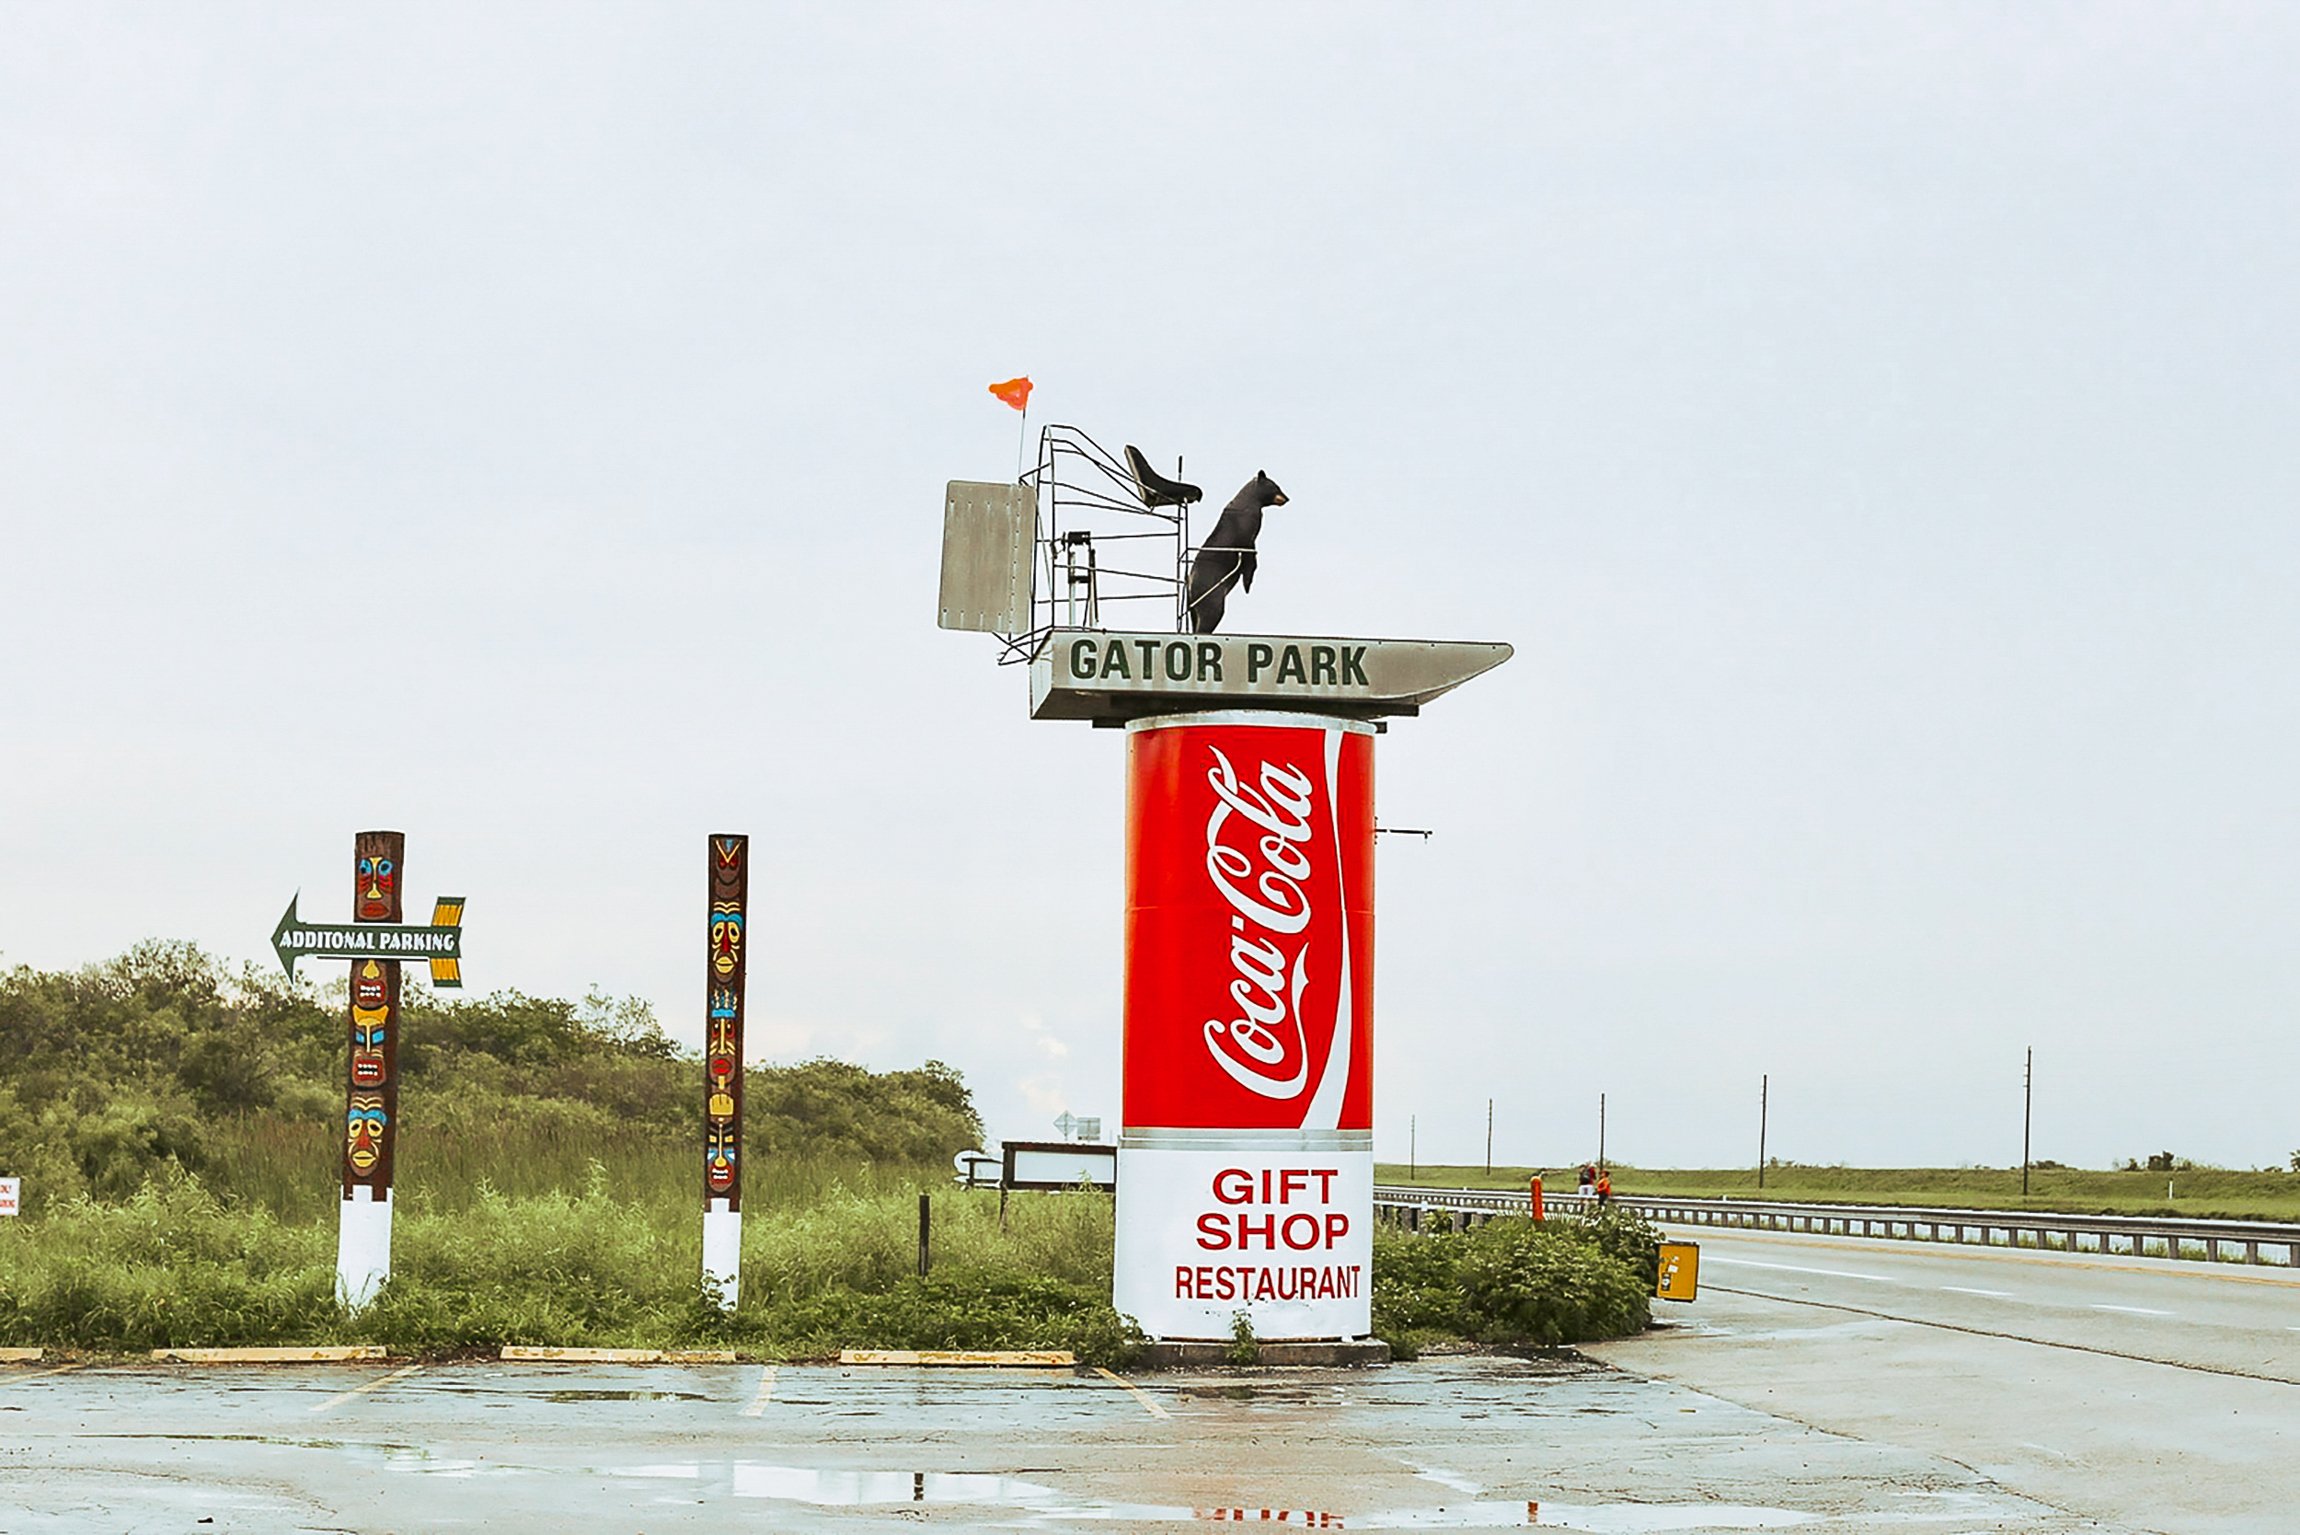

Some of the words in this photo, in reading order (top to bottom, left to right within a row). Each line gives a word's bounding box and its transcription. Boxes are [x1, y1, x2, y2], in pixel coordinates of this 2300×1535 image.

[1070, 638, 1223, 682] GATOR
[1247, 643, 1370, 686] PARK
[279, 930, 375, 950] ADDITONAL
[379, 932, 455, 951] PARKING
[1203, 744, 1314, 1100] Coca-Cola
[1212, 1168, 1339, 1205] GIFT
[1196, 1213, 1350, 1251] SHOP
[1175, 1265, 1361, 1300] RESTAURANT
